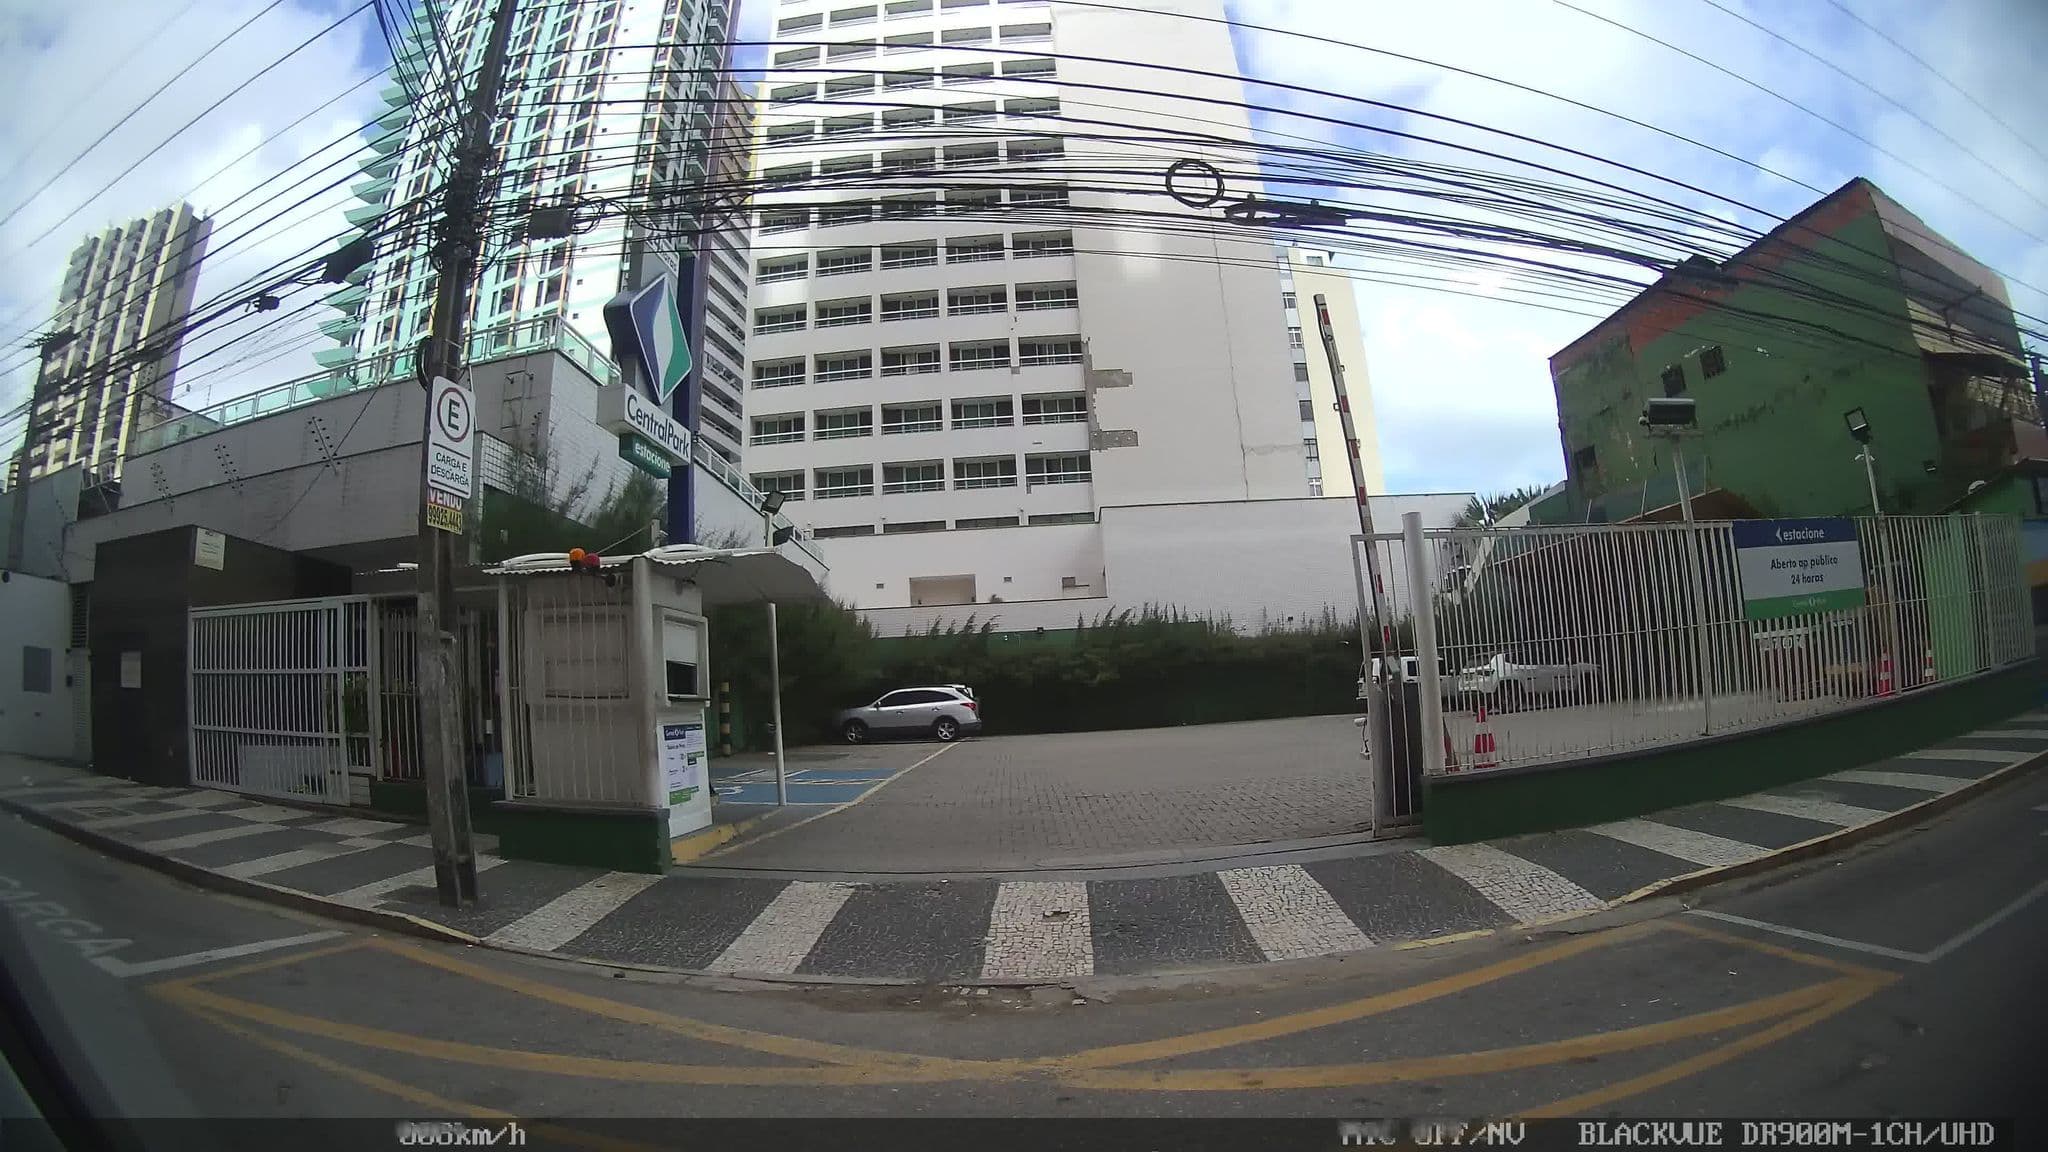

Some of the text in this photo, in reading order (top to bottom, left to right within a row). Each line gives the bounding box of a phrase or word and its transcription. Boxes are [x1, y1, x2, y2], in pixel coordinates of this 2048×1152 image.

[448, 398, 460, 431] E
[627, 394, 690, 458] CentralPark
[435, 452, 467, 472] CARGA E
[634, 442, 671, 472] estacione
[430, 464, 470, 486] DESCARGA
[429, 488, 462, 511] VENDO
[1783, 527, 1825, 541] estacione
[1770, 558, 1797, 570] Aberto
[1791, 573, 1824, 585] 24 horas
